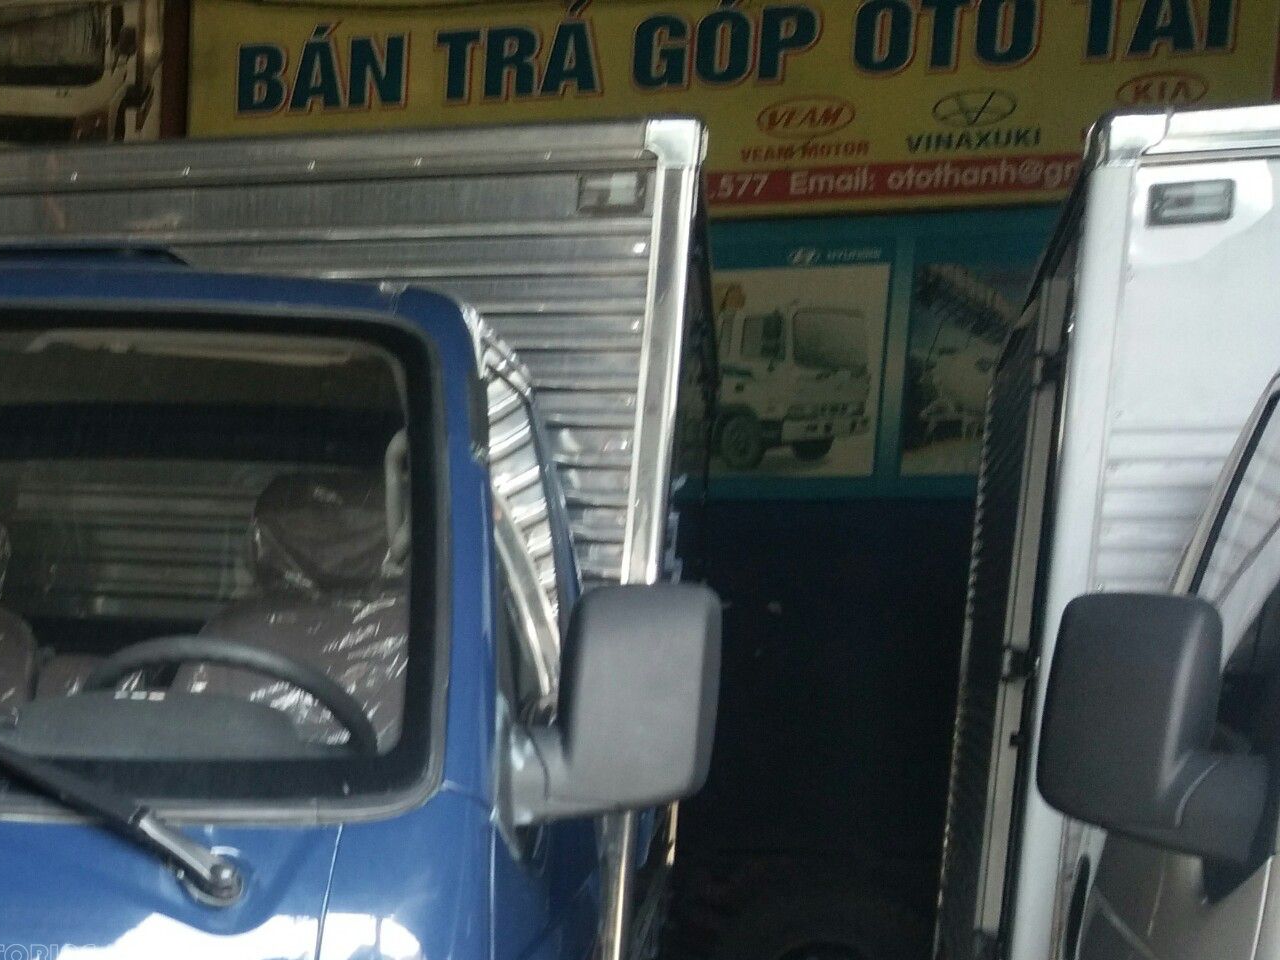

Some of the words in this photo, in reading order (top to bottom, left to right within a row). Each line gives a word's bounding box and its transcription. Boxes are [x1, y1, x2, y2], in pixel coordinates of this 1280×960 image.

[235, 21, 408, 115] BÁN
[1131, 81, 1194, 102] KIA
[905, 126, 1042, 154] VINAXUKI
[789, 167, 874, 195] Email:
